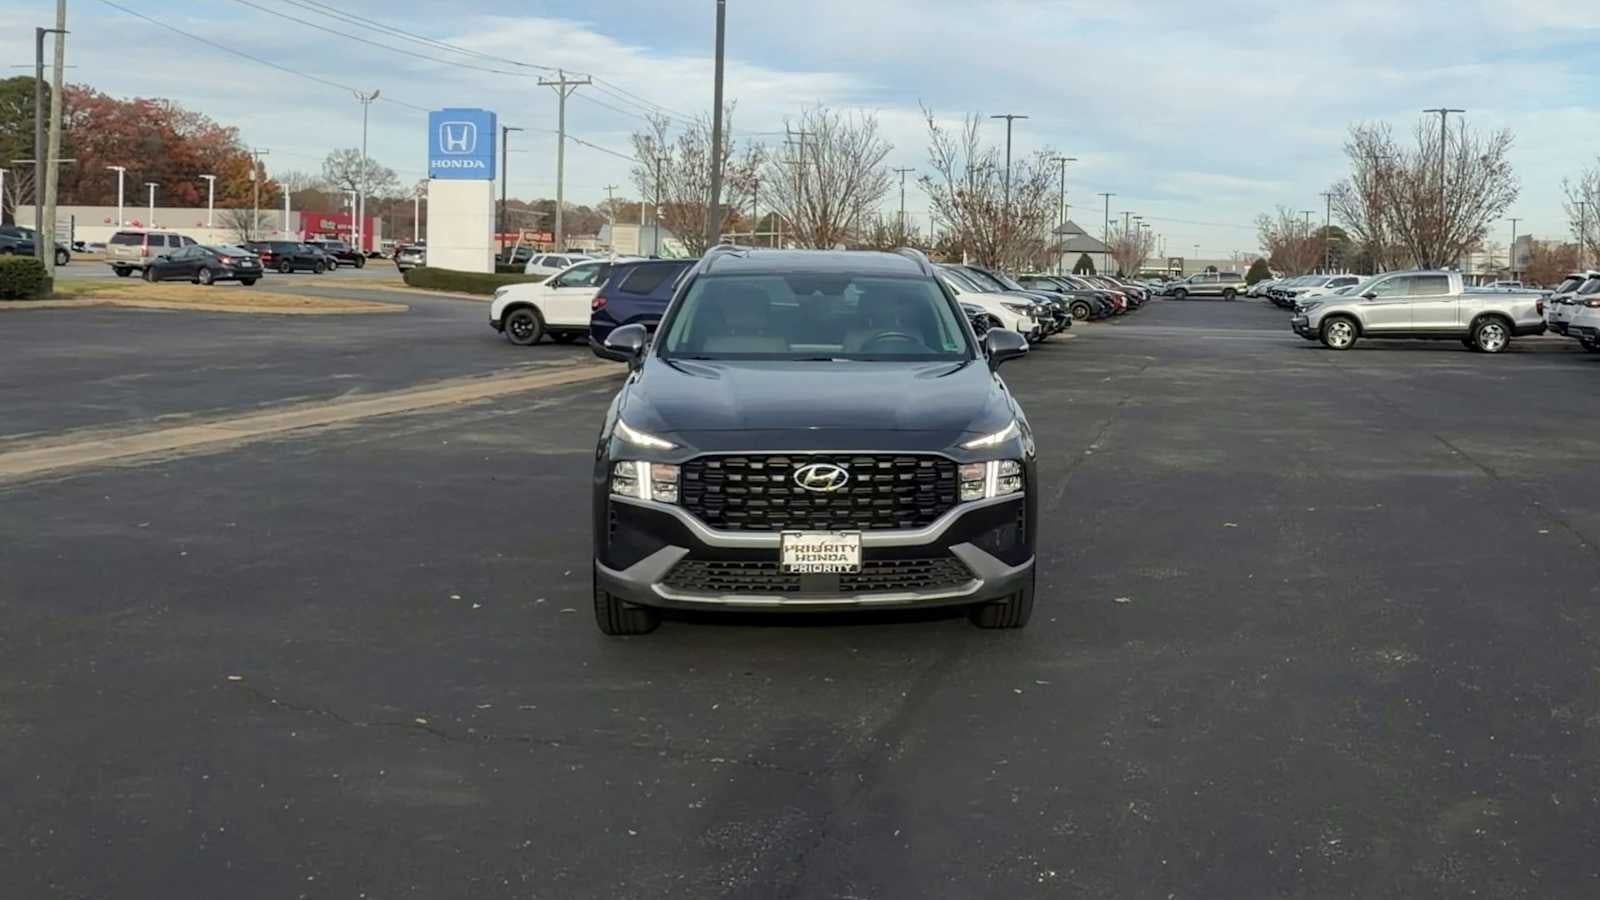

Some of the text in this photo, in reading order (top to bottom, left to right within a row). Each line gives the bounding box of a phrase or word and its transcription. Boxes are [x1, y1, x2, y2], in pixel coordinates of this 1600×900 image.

[431, 160, 486, 168] HONDA
[784, 542, 857, 553] PRIORITY
[795, 554, 848, 562] HONDA
[790, 564, 852, 573] PRIORITY
